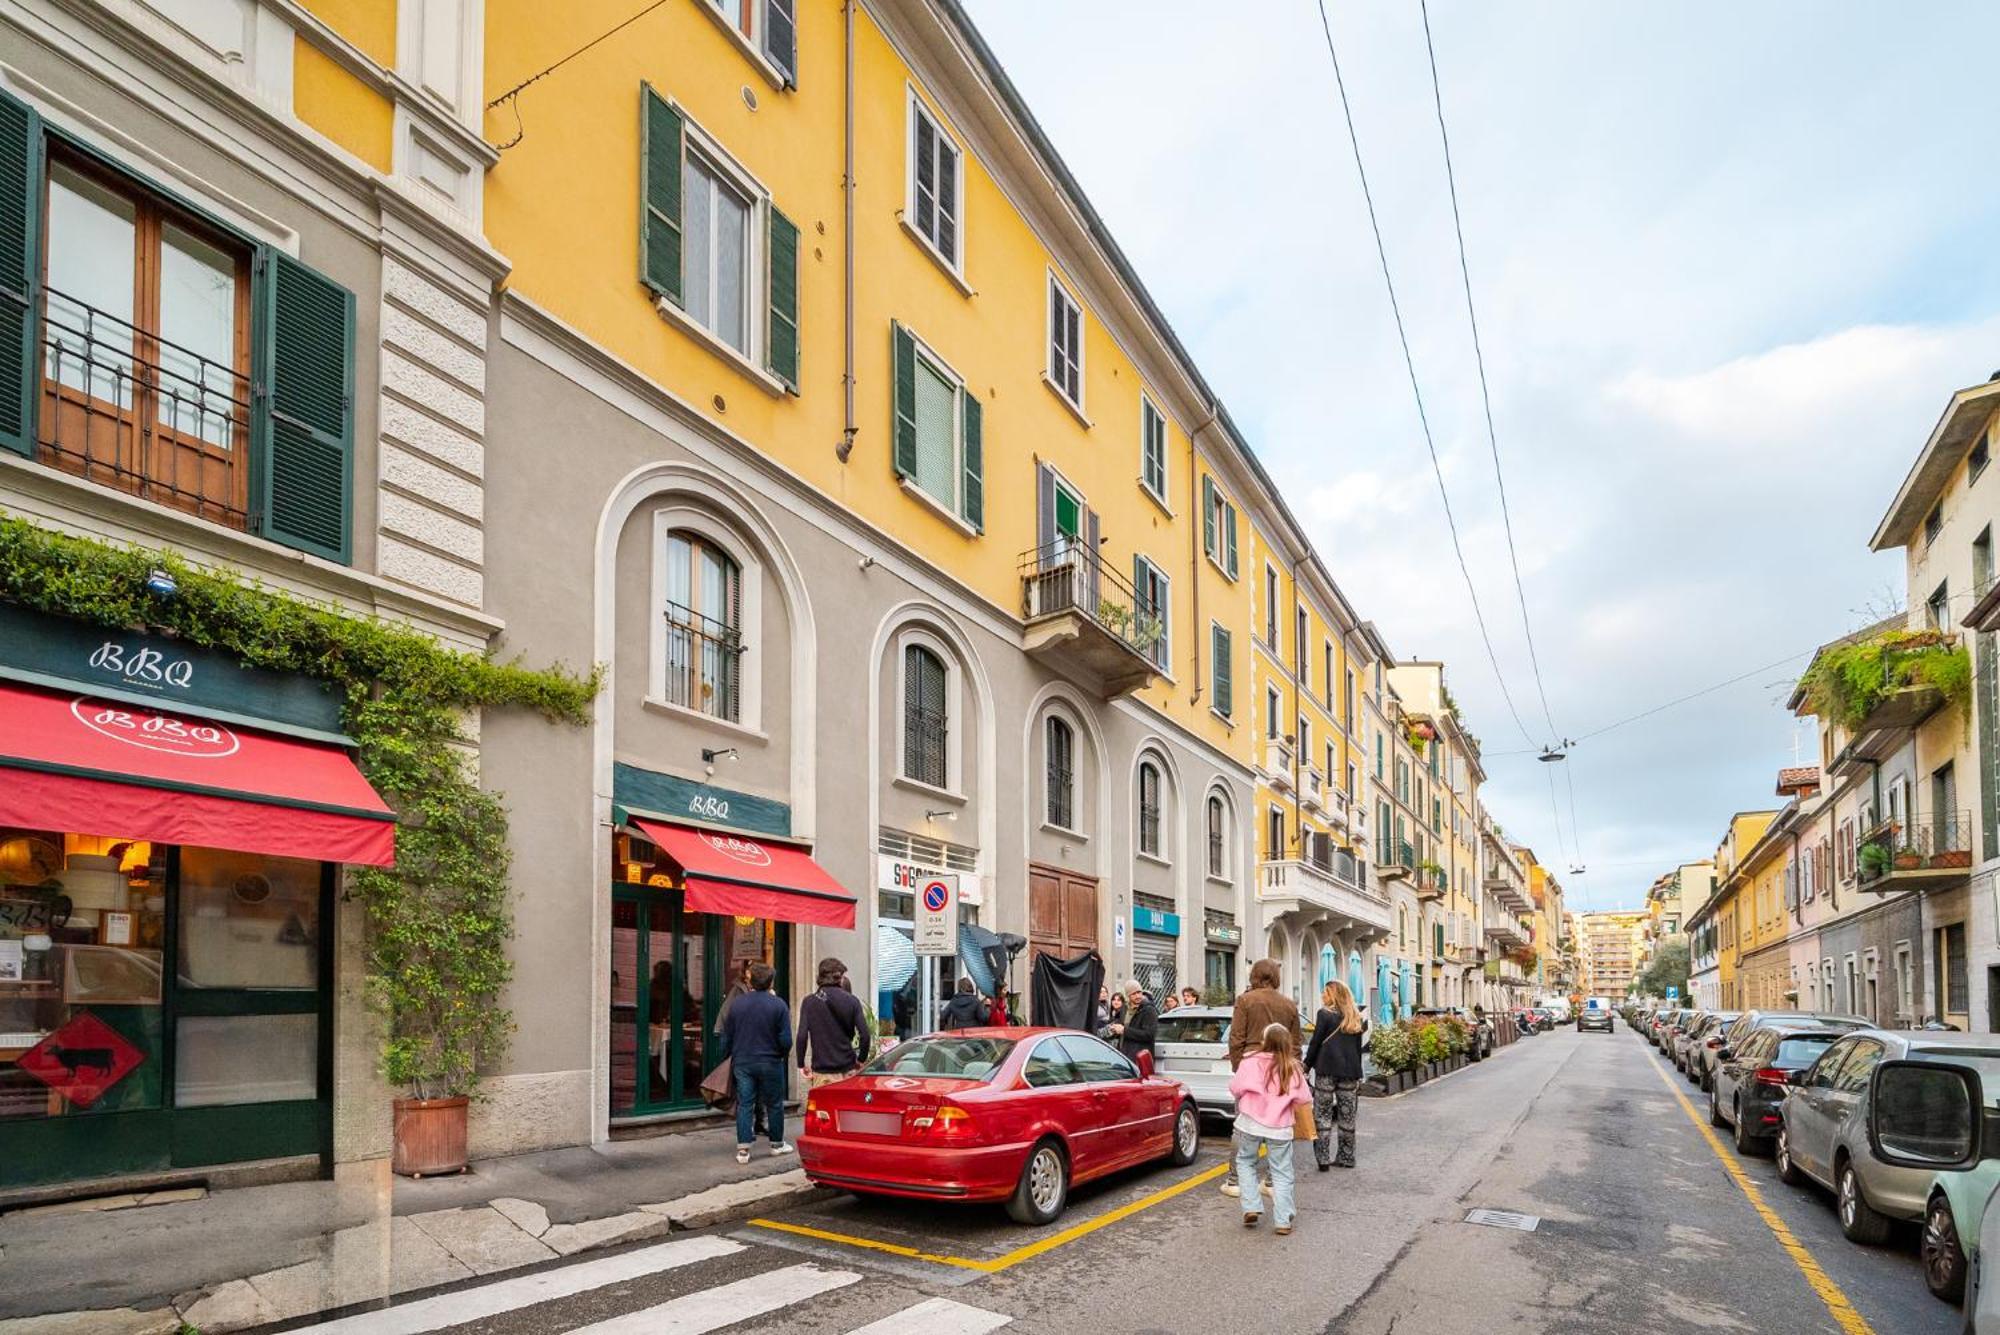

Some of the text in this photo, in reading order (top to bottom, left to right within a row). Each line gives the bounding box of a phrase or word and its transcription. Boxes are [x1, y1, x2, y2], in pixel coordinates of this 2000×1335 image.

[89, 641, 193, 688] BBQ
[94, 709, 224, 743] BBQ
[688, 794, 729, 819] BBQ
